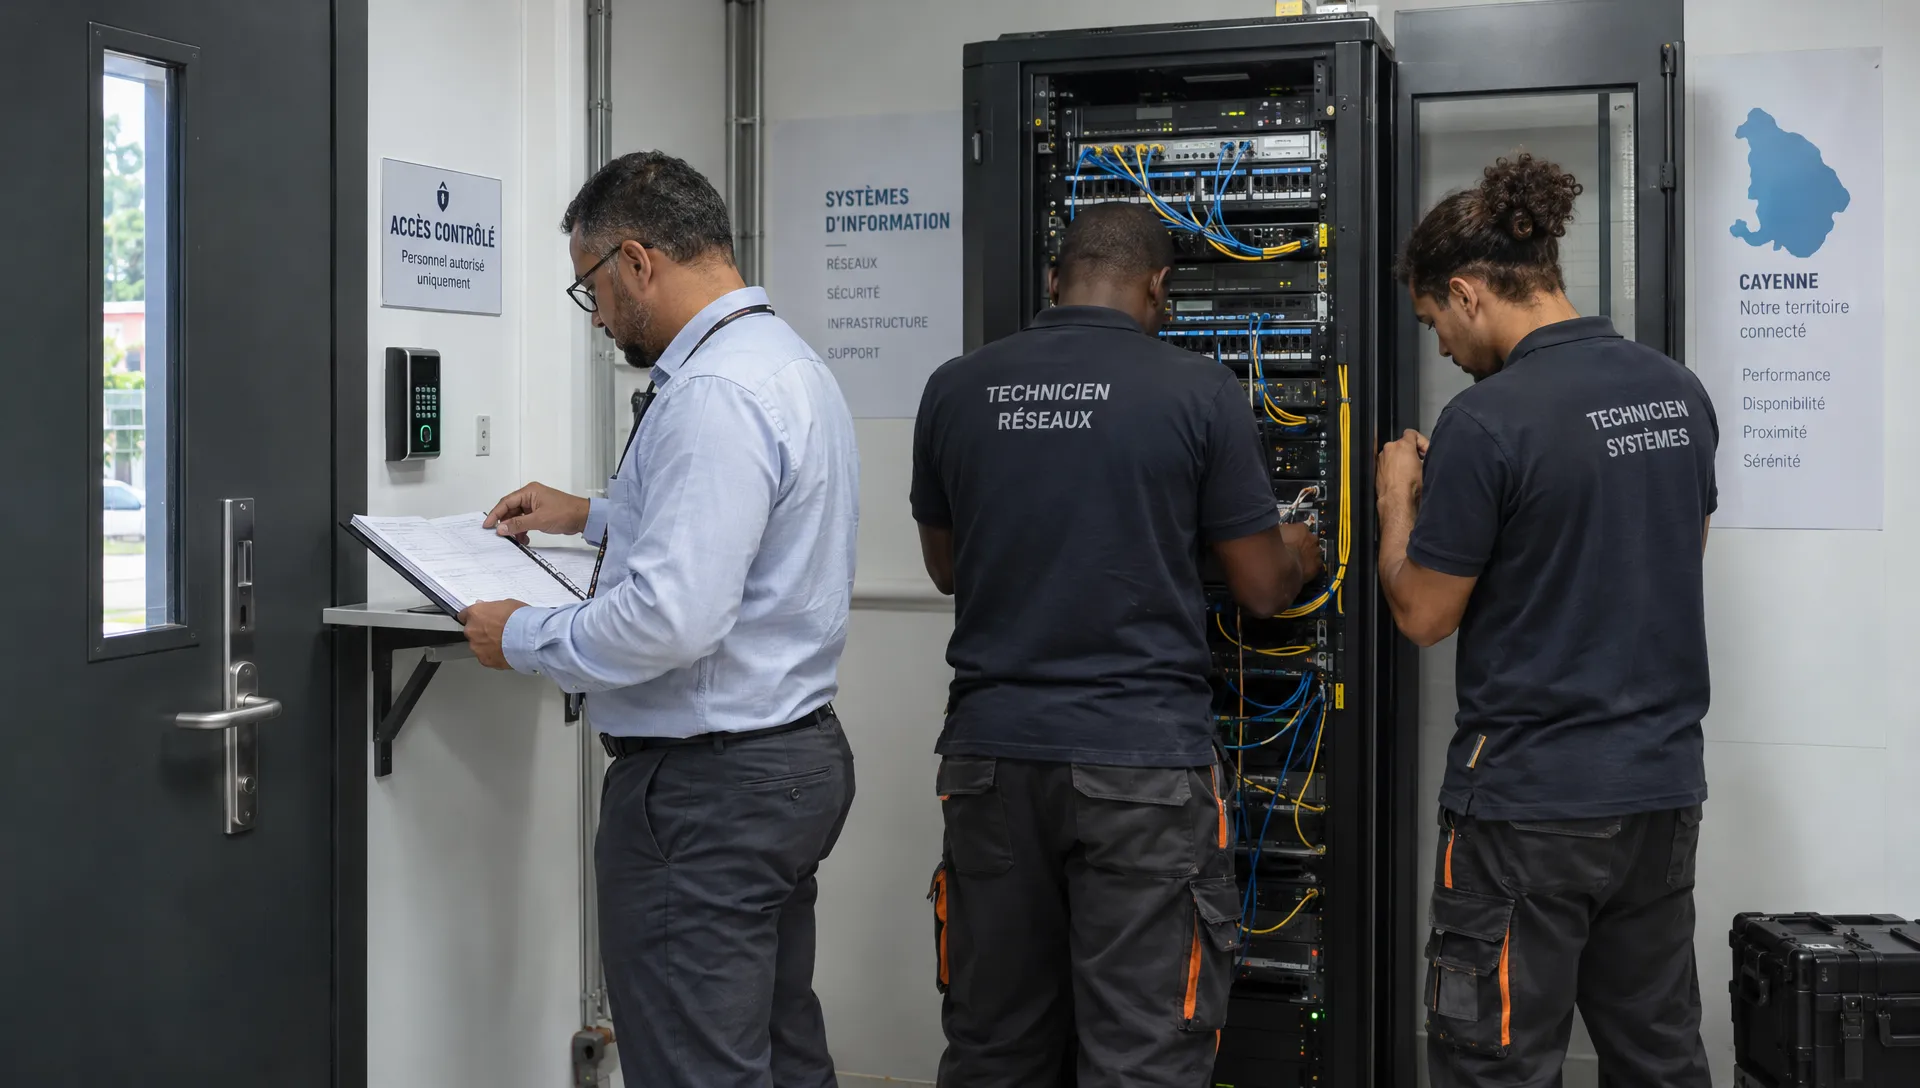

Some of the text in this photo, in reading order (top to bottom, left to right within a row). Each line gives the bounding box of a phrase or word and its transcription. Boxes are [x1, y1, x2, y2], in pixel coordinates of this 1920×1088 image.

[825, 185, 910, 208] SYSTÈMES
[390, 213, 495, 248] ACCÈS CONTRÔLÉ
[826, 212, 950, 233] D'INFORMATION
[401, 249, 485, 272] Personnel autorisé
[826, 256, 879, 270] RÉSEAUX
[417, 272, 471, 290] uniquement
[1739, 272, 1819, 290] CAYENNE
[827, 285, 880, 300] SÉCURITÉ
[1740, 298, 1850, 315] Notre territoire
[827, 316, 929, 329] INFRASTRUCTURE
[1740, 322, 1807, 339] connecté
[827, 347, 880, 360] SUPPORT
[1742, 367, 1831, 382] Performance
[986, 383, 1111, 403] TECHNICIEN
[1743, 396, 1826, 413] Disponibilité
[998, 406, 1094, 430] RÉSEAUX
[1585, 400, 1690, 431] TECHNICIEN
[1743, 424, 1808, 439] Proximité
[1606, 427, 1690, 457] SYSTÈMES
[1743, 453, 1801, 468] Sérénité
